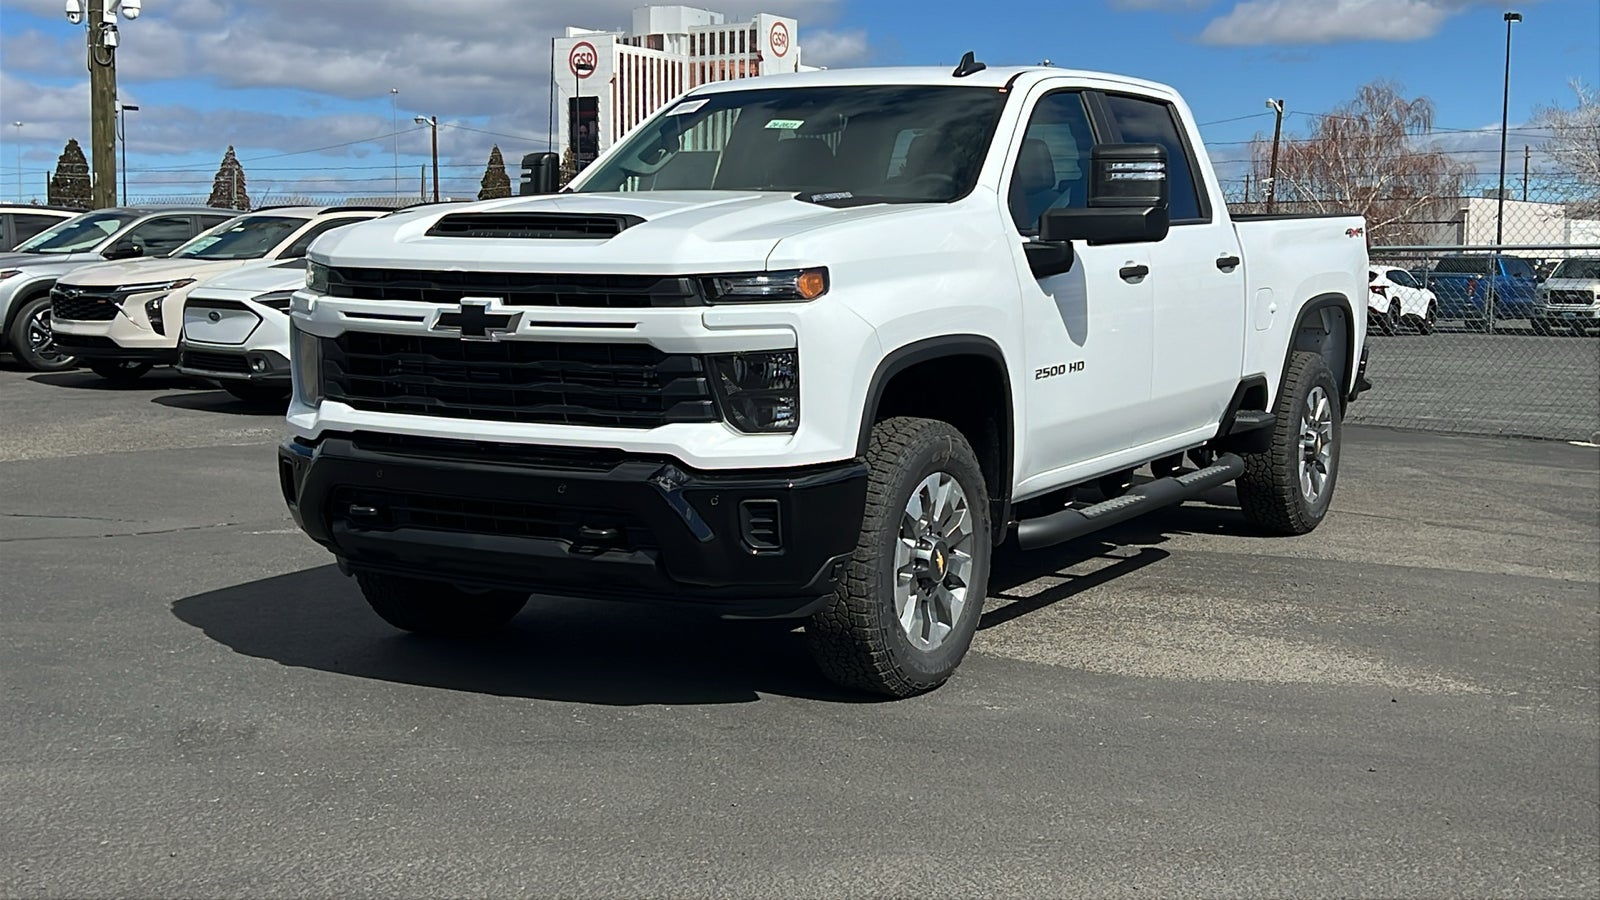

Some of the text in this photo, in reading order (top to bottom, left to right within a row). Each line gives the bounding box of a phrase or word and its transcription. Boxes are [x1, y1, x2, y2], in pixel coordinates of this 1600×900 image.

[772, 32, 787, 48] GSR
[1035, 361, 1085, 380] 2500 HD
